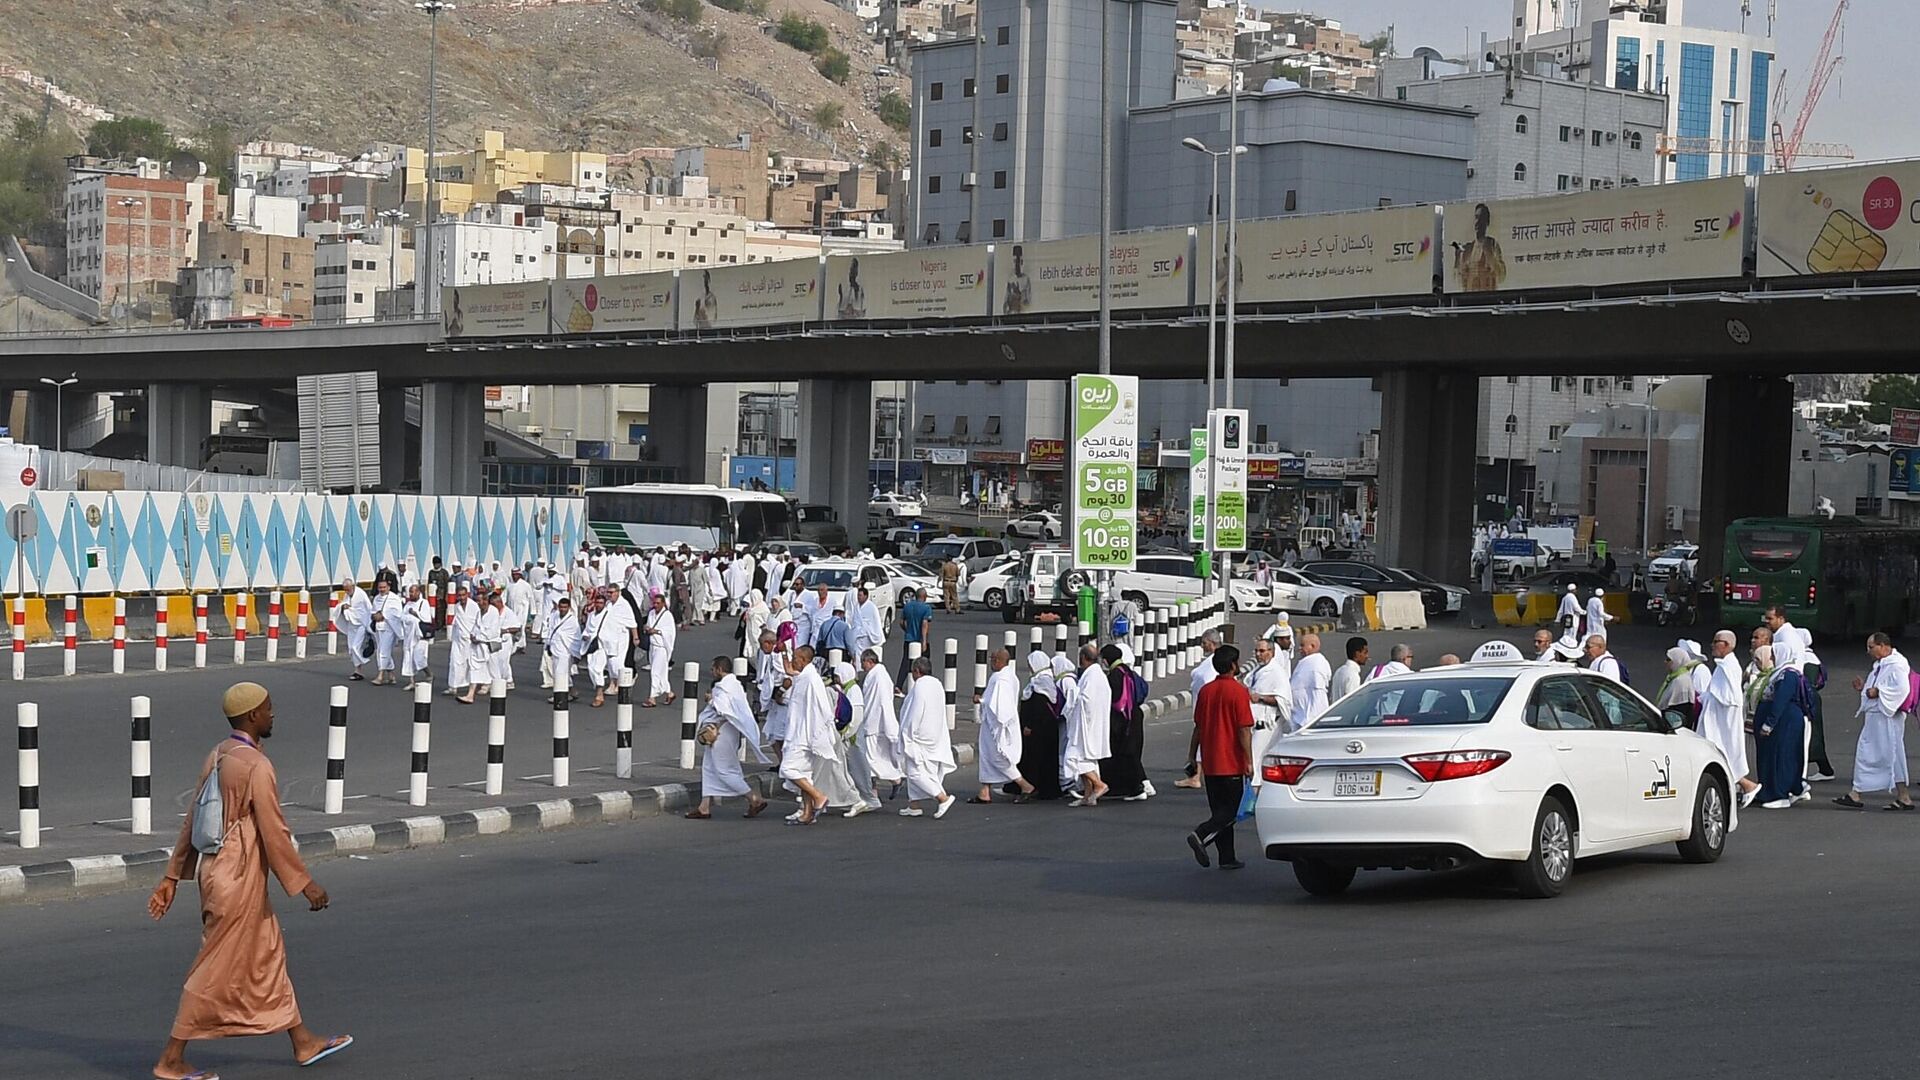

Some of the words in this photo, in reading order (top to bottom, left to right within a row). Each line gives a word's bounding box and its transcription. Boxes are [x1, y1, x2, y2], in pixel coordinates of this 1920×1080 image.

[1870, 200, 1881, 209] SR
[1883, 198, 1894, 208] 30
[1512, 225, 1539, 240] भारत
[1545, 217, 1576, 238] आपसे
[1582, 218, 1615, 234] ज्यादा
[1621, 211, 1651, 231] करीब
[1694, 218, 1720, 233] STC
[1110, 247, 1139, 262] alaysia
[1393, 242, 1414, 255] STC
[921, 261, 947, 275] Nigeria
[1040, 266, 1059, 279] lebih
[1061, 265, 1082, 278] dekat
[1153, 260, 1169, 273] STC
[891, 280, 897, 291] is
[899, 278, 920, 291] closer
[923, 279, 931, 289] to
[960, 274, 974, 284] STC
[795, 283, 806, 293] STC
[600, 297, 620, 310] Closer
[623, 298, 631, 308] to
[653, 295, 663, 303] STC
[1081, 384, 1112, 404] زين
[1082, 437, 1107, 448] الحج
[1109, 436, 1133, 450] باقة
[1088, 447, 1130, 460] والعمرة
[1085, 468, 1101, 492] 5
[1103, 478, 1128, 493] GB
[1087, 497, 1109, 506] يوم
[1110, 494, 1125, 504] 30
[1083, 528, 1107, 548] 10
[1109, 536, 1130, 548] GB
[1088, 553, 1110, 562] يوم
[1111, 550, 1127, 560] 90
[1747, 589, 1753, 598] 9
[1337, 785, 1357, 794] 9106
